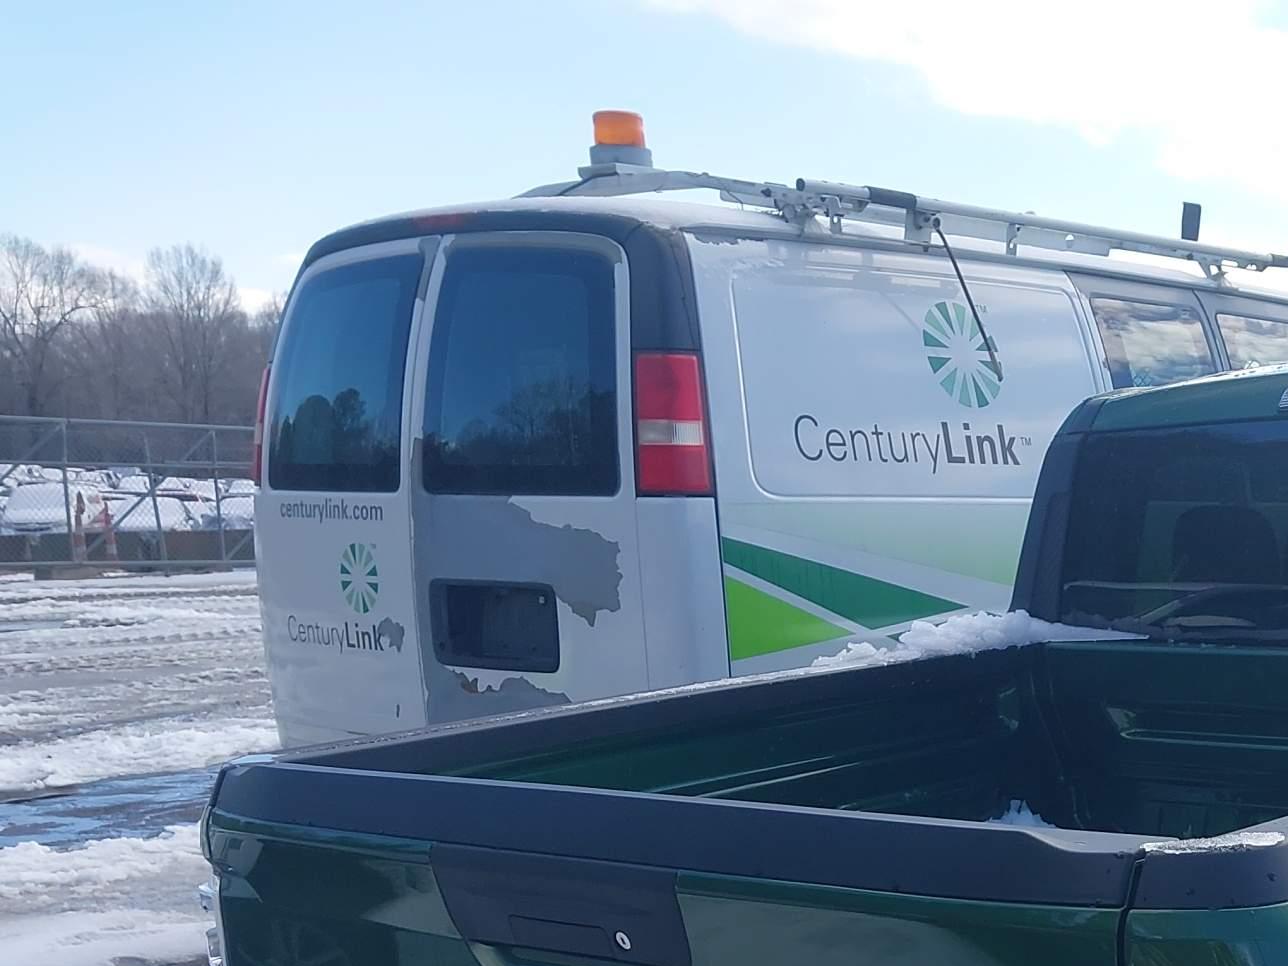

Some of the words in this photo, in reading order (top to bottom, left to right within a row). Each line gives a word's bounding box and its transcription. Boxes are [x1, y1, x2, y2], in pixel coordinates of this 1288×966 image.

[793, 414, 1021, 475] CenturyLink
[280, 497, 384, 524] centurylink.com
[287, 614, 385, 655] CenturyLink
